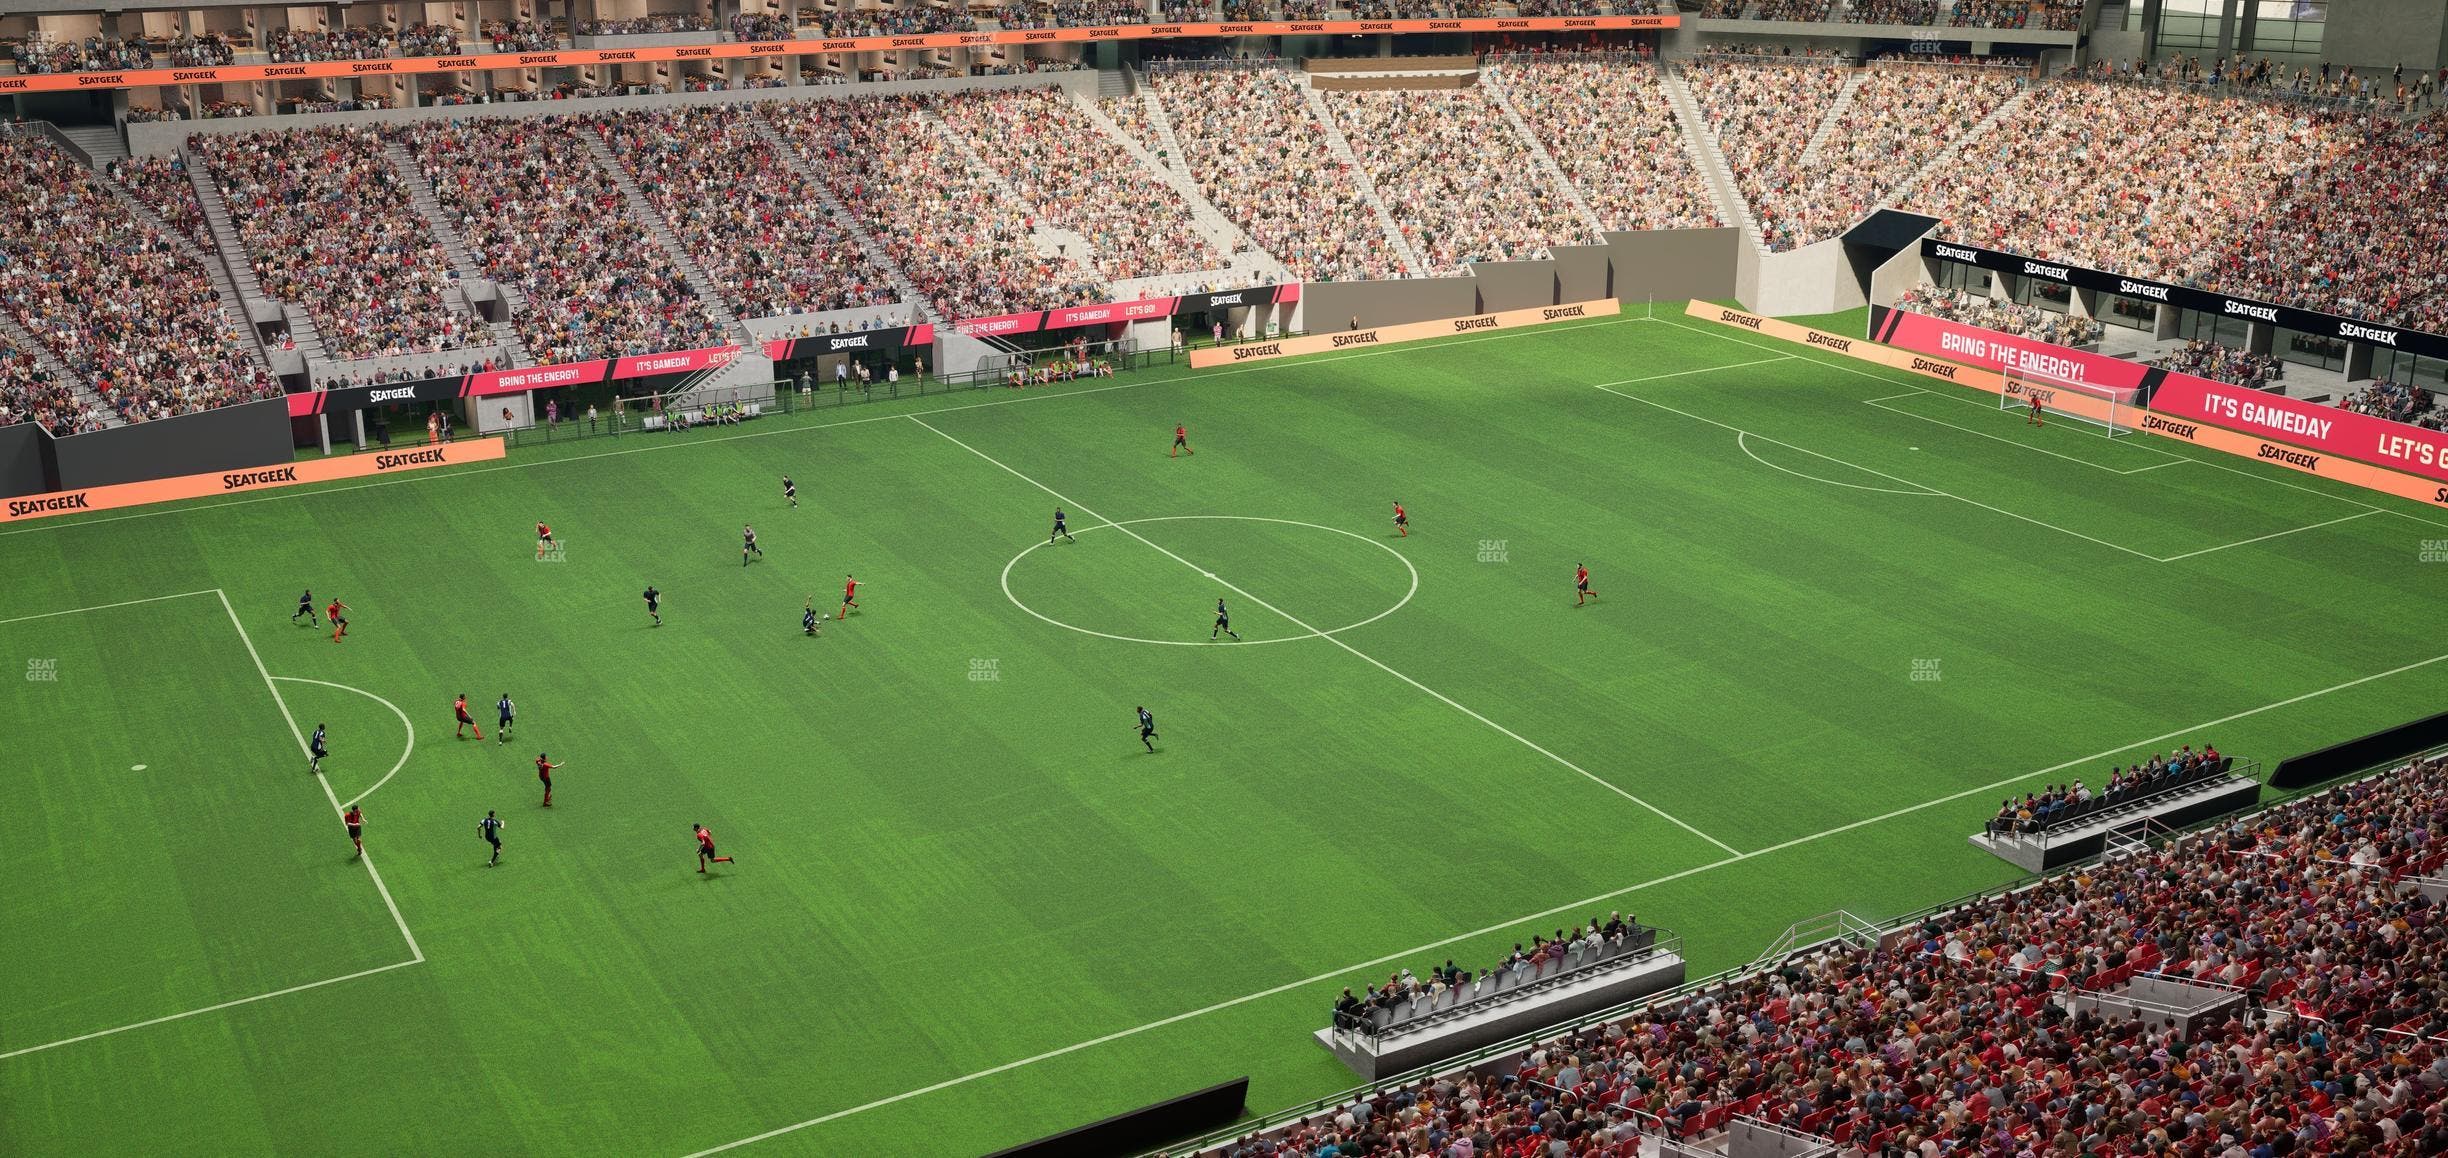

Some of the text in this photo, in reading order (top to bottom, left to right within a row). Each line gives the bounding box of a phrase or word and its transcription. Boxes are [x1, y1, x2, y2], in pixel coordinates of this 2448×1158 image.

[1220, 25, 1253, 33] SEATGEEK
[1291, 24, 1324, 32] SEATGEEK
[1360, 22, 1393, 31] SEATGEEK
[1429, 21, 1462, 30] SEATGEEK
[1498, 20, 1529, 29] SEATGEEK
[1565, 19, 1596, 28] SEATGEEK
[1631, 18, 1662, 27] SEATGEEK
[1026, 32, 1056, 41] SEATGEEK
[1090, 29, 1119, 38] SEATGEEK
[1151, 26, 1182, 35] SEATGEEK
[751, 44, 785, 54] SEATGEEK
[823, 41, 856, 50] SEATGEEK
[893, 37, 925, 47] SEATGEEK
[600, 51, 636, 61] SEATGEEK
[676, 48, 712, 57] SEATGEEK
[438, 58, 477, 69] SEATGEEK
[520, 55, 558, 65] SEATGEEK
[264, 66, 306, 77] SEATGEEK
[353, 62, 393, 73] SEATGEEK
[79, 75, 124, 85] SEATGEEK
[173, 70, 217, 81] SEATGEEK
[1936, 245, 1977, 264] SEATGEEK
[2024, 261, 2069, 281] SEATGEEK
[2120, 280, 2169, 301] SEATGEEK
[1210, 293, 1243, 306] SEATGEEK
[1080, 309, 1110, 321] GAMEDAY
[1544, 304, 1585, 321] SEATGEEK
[2224, 300, 2278, 322] SEATGEEK
[989, 320, 1018, 331] ENERGY!
[1455, 315, 1498, 332] SEATGEEK
[1721, 310, 1763, 330] SEATGEEK
[1333, 330, 1379, 348] SEATGEEK
[2339, 322, 2398, 346] SEATGEEK
[830, 335, 869, 350] SEATGEEK
[1806, 331, 1852, 352] SEATGEEK
[1233, 342, 1282, 360] SEATGEEK
[1941, 331, 2085, 382] BRING THE ENERGY!
[653, 356, 691, 370] GAMEDAY
[1911, 357, 1957, 379] SEATGEEK
[499, 369, 580, 388] BRING THE ENERGY!
[370, 386, 416, 403] SEATGEEK
[2005, 380, 2056, 404] SEATGEEK
[2204, 393, 2333, 440] IT'S GAMEDAY
[2141, 414, 2198, 440] SEATGEEK
[2378, 433, 2434, 465] LET'S
[376, 447, 446, 470] SEATGEEK
[2257, 443, 2320, 470] SEATGEEK
[224, 466, 297, 489] SEATGEEK
[8, 492, 89, 517] SEATGEEK
